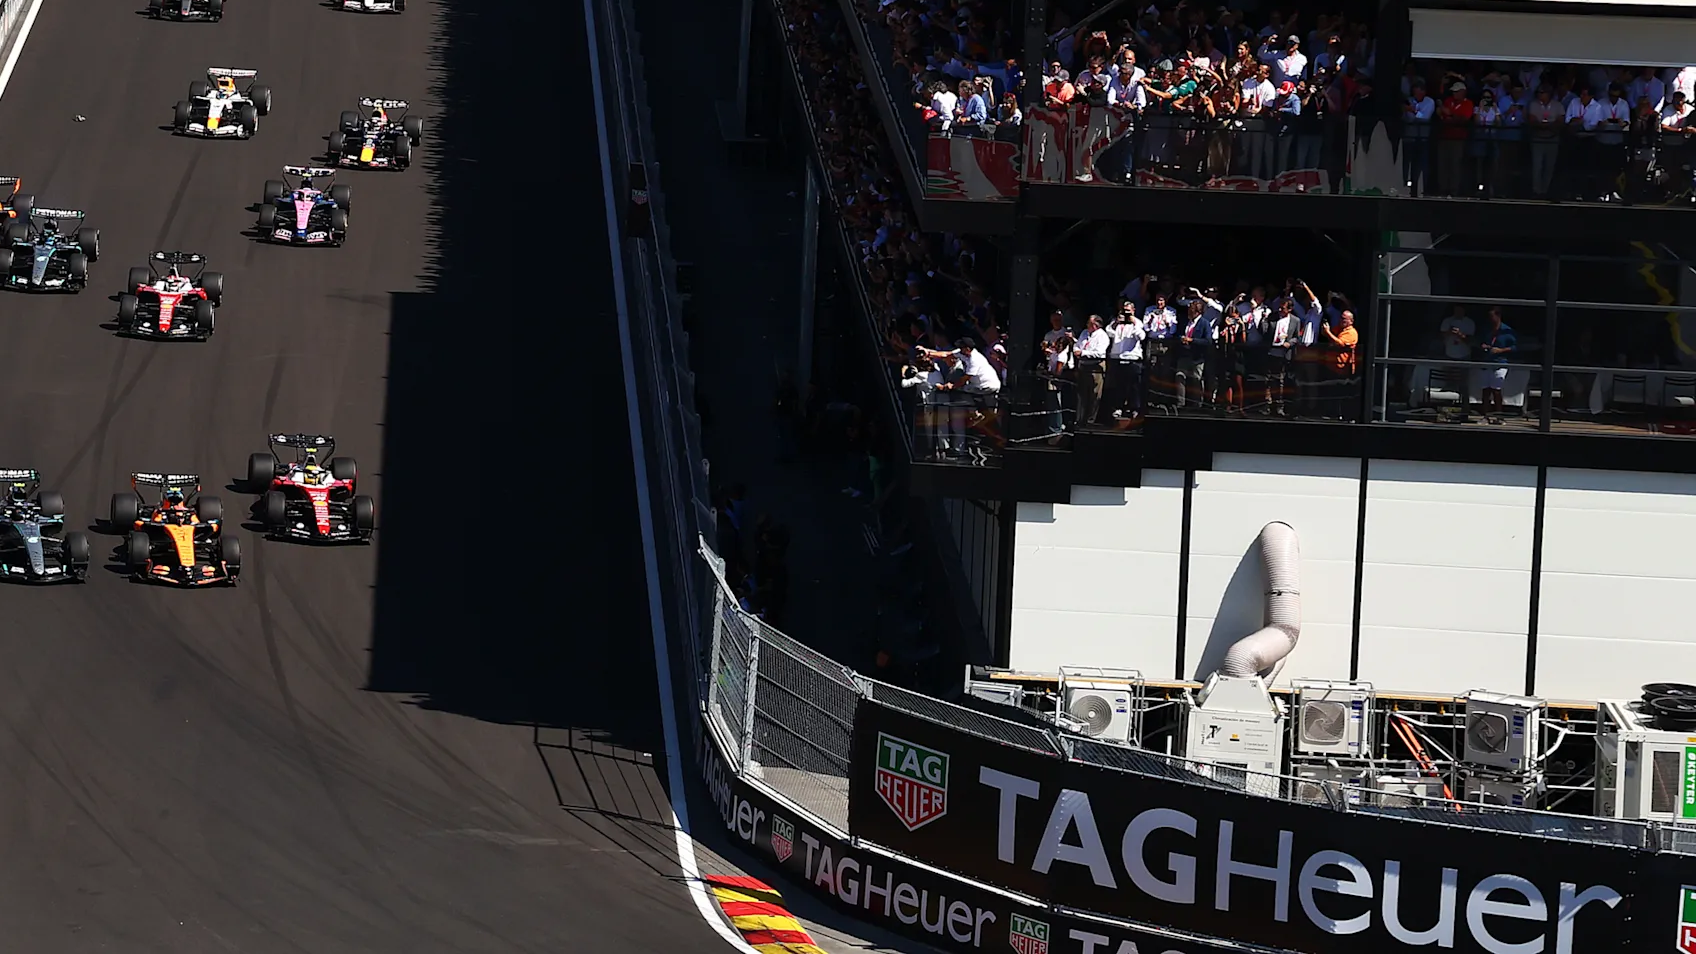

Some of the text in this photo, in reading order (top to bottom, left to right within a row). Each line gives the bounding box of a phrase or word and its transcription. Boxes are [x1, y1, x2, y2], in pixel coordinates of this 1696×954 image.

[35, 208, 78, 218] PETRONAS
[882, 739, 946, 784] TAG
[1685, 761, 1696, 805] KEYTER
[701, 738, 766, 846] TAGHeuer
[879, 770, 946, 830] HEUER
[773, 816, 795, 843] TAG
[978, 765, 1623, 954] TAGHeuer
[801, 832, 997, 948] TAGHeuer
[1010, 931, 1048, 954] HEUER
[1011, 915, 1047, 935] TAG
